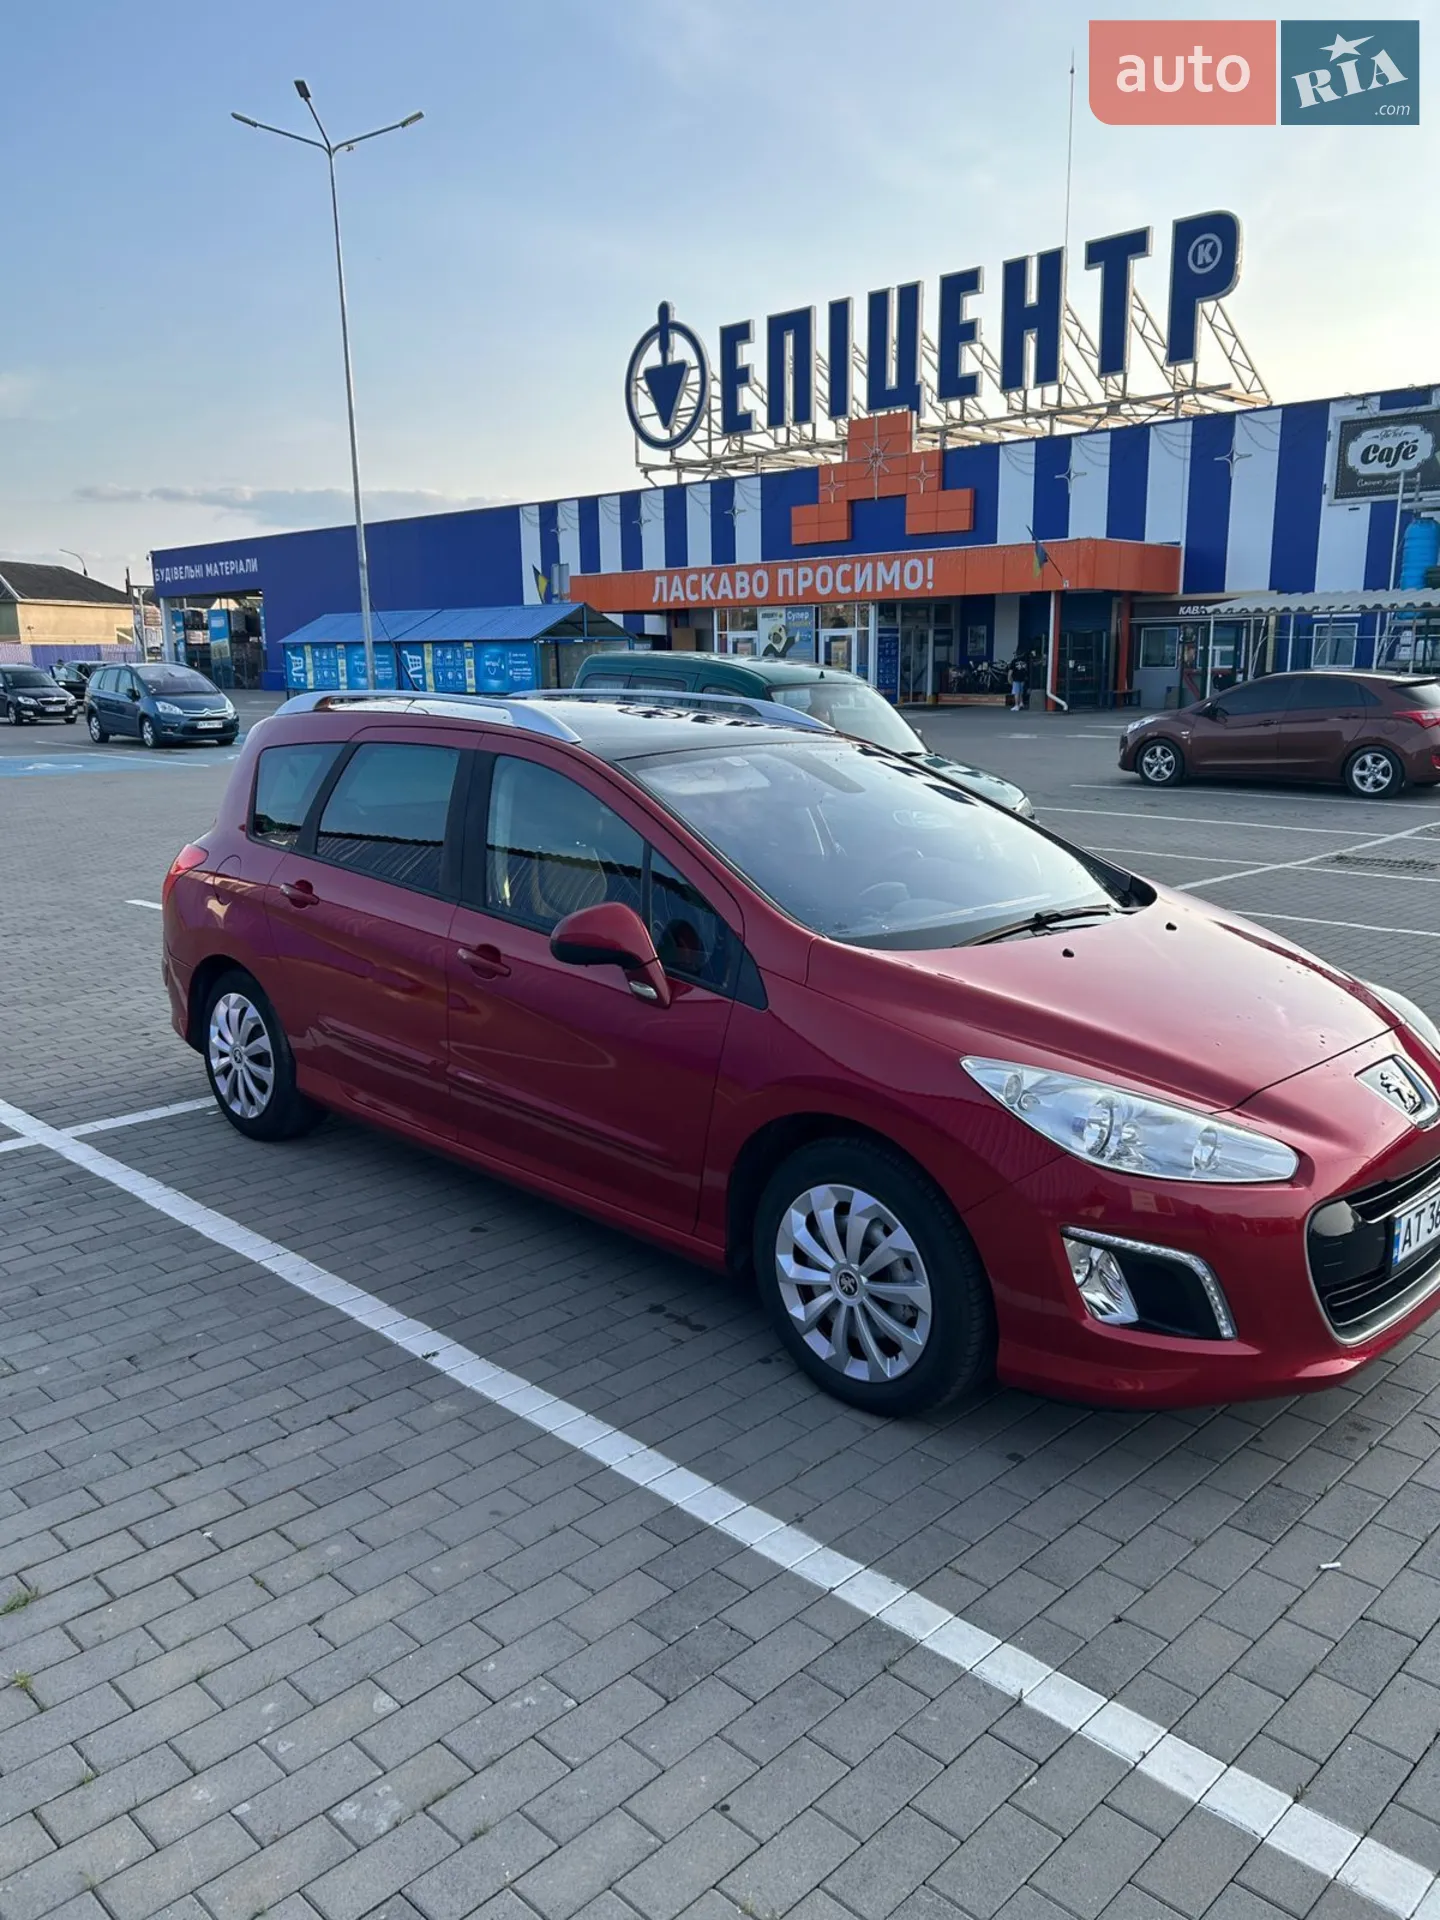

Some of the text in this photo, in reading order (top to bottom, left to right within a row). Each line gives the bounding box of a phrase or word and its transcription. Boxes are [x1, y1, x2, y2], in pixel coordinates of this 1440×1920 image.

[719, 209, 1243, 435] ЕПІЦЕНТР
[1361, 439, 1419, 468] Café
[154, 557, 259, 583] БУДІВЕЛЬНІ МАТЕРІАЛИ
[652, 557, 935, 603] ЛАСКАВО ПРОСИМО!
